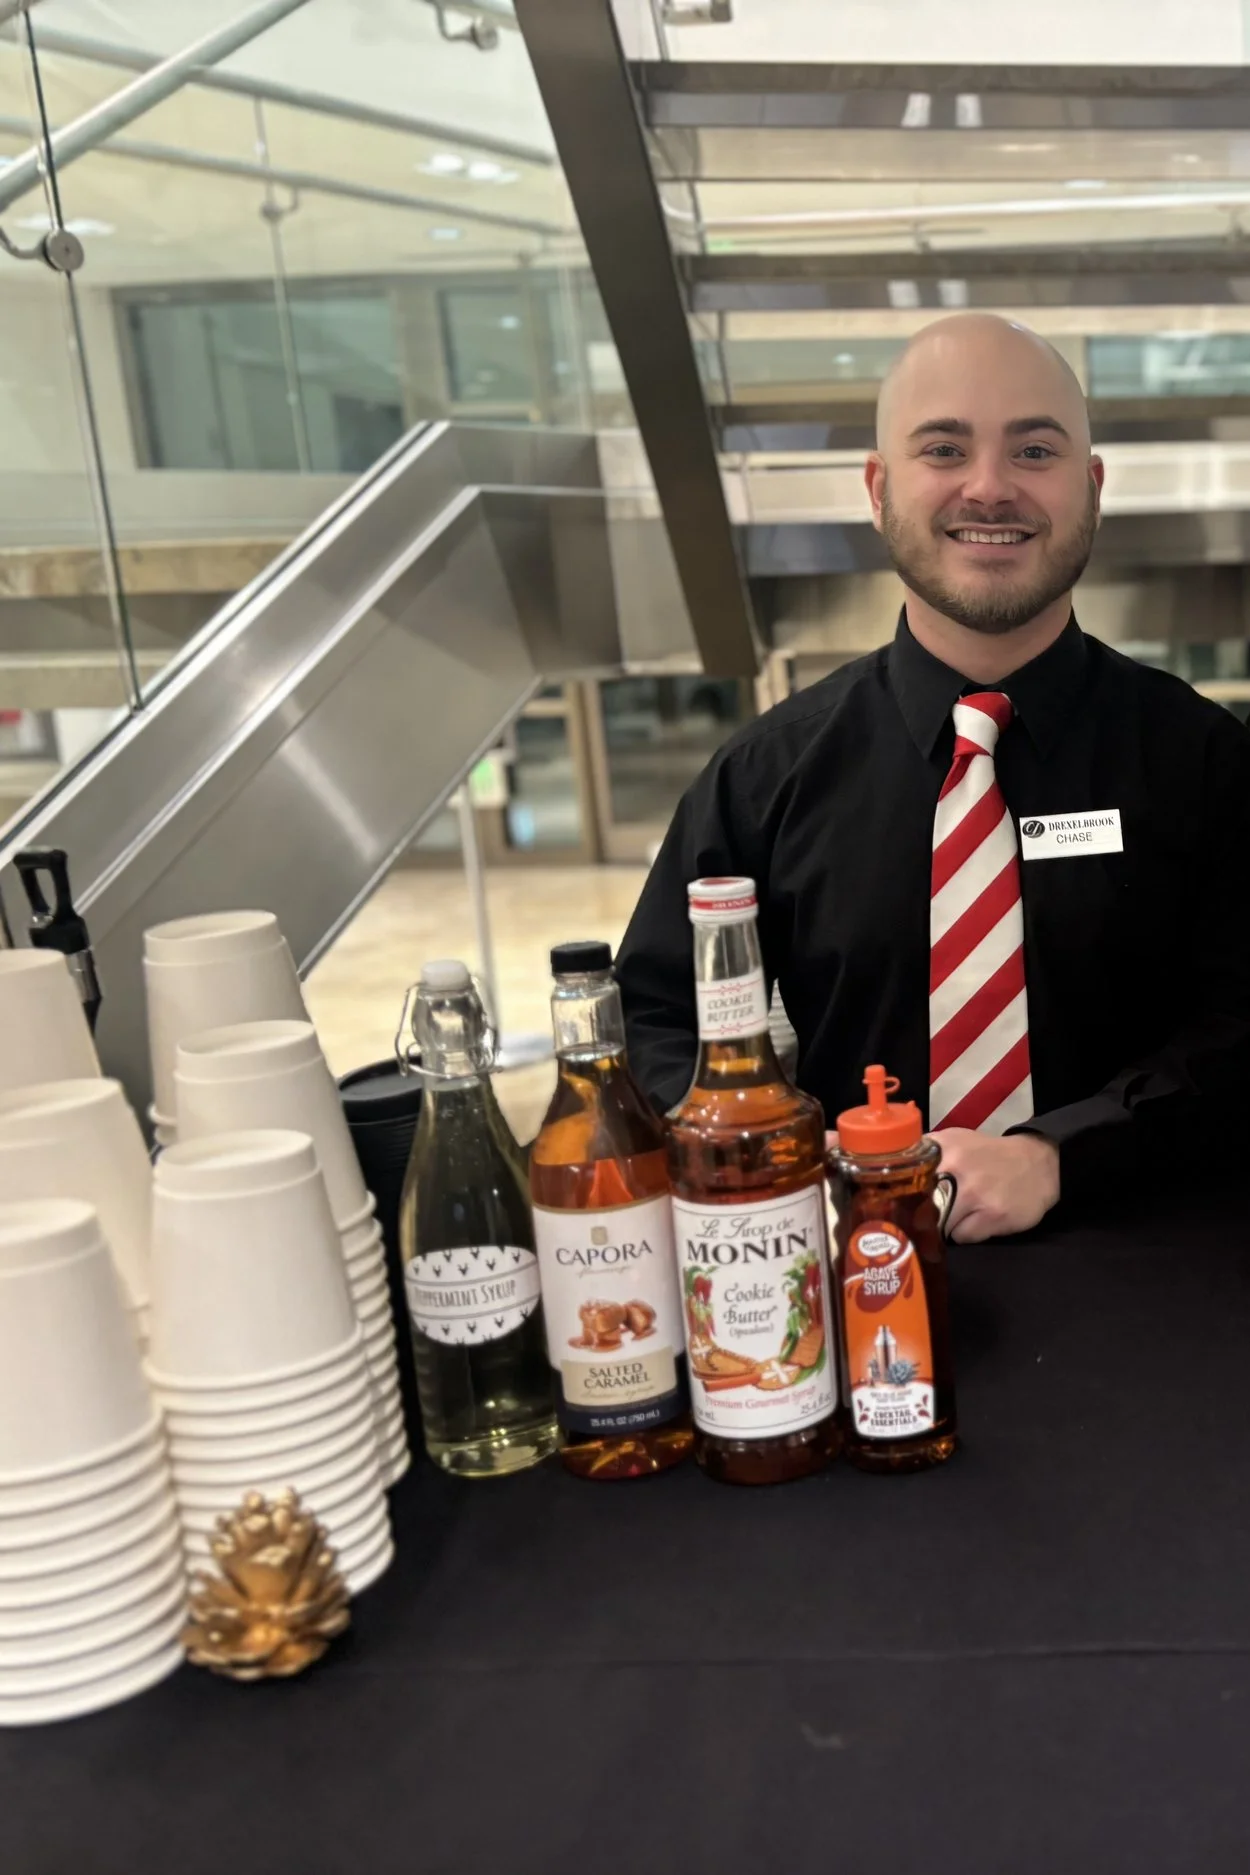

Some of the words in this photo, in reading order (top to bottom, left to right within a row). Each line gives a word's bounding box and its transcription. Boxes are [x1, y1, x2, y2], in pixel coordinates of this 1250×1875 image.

[1048, 816, 1114, 832] DREXELBROOK
[1056, 831, 1093, 844] CHASE
[707, 992, 753, 1010] COOKIE
[707, 1004, 755, 1023] BUTTER
[695, 1218, 720, 1239] Le
[723, 1217, 773, 1241] Sirop
[776, 1216, 795, 1231] de
[555, 1239, 653, 1266] CAPORA
[687, 1227, 808, 1264] MONIN
[863, 1265, 899, 1281] AGAVE
[480, 1279, 516, 1304] SYRUP
[724, 1282, 775, 1303] Cookie
[863, 1280, 901, 1296] SYRUP
[723, 1304, 779, 1324] Butter
[589, 1362, 643, 1378] SALTED
[584, 1371, 652, 1389] CARAMEL
[704, 1394, 743, 1410] Premium
[745, 1395, 790, 1409] Gourmet
[870, 1415, 917, 1426] ESSENTIALS
[873, 1408, 912, 1419] COCKTAIL
